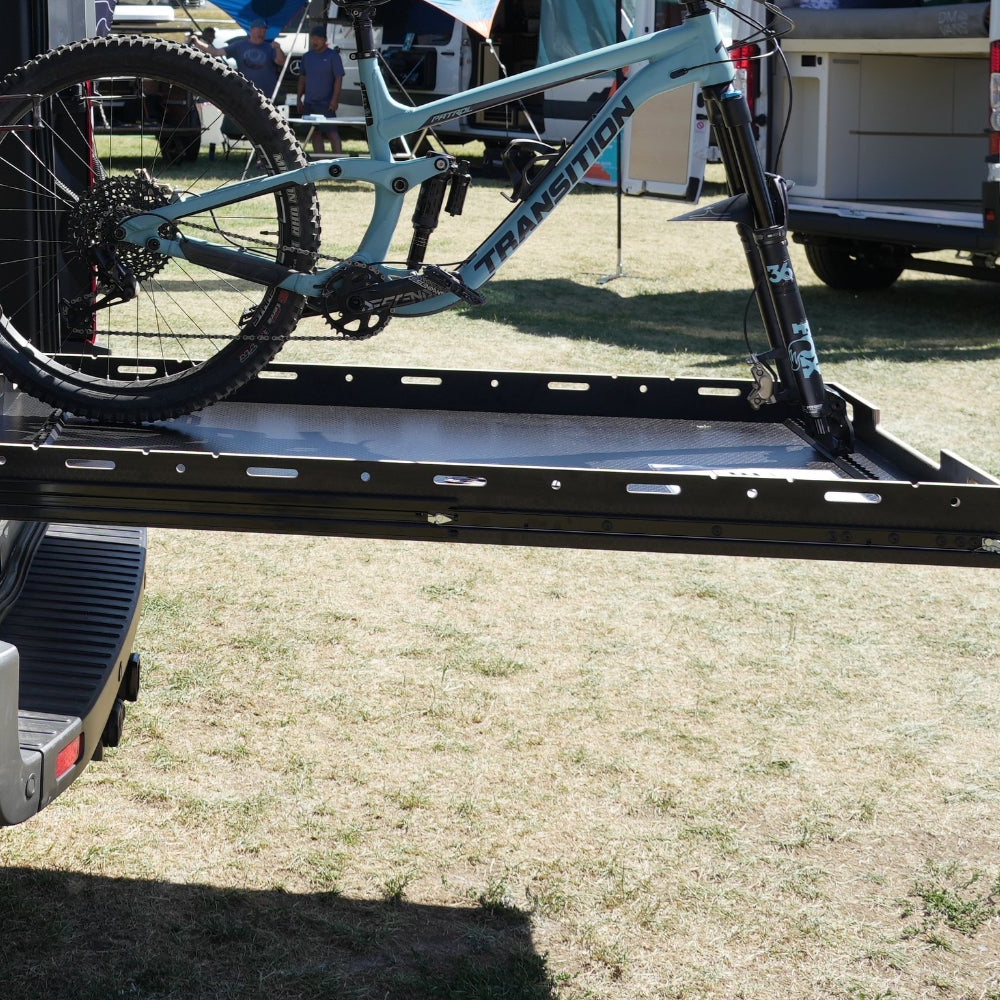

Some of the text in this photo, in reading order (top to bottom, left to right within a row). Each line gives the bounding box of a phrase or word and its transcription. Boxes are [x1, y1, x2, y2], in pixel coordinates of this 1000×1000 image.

[430, 106, 473, 124] PATROL
[473, 94, 636, 275] TRANSITION
[766, 262, 793, 283] 36
[788, 319, 822, 379] FOX
